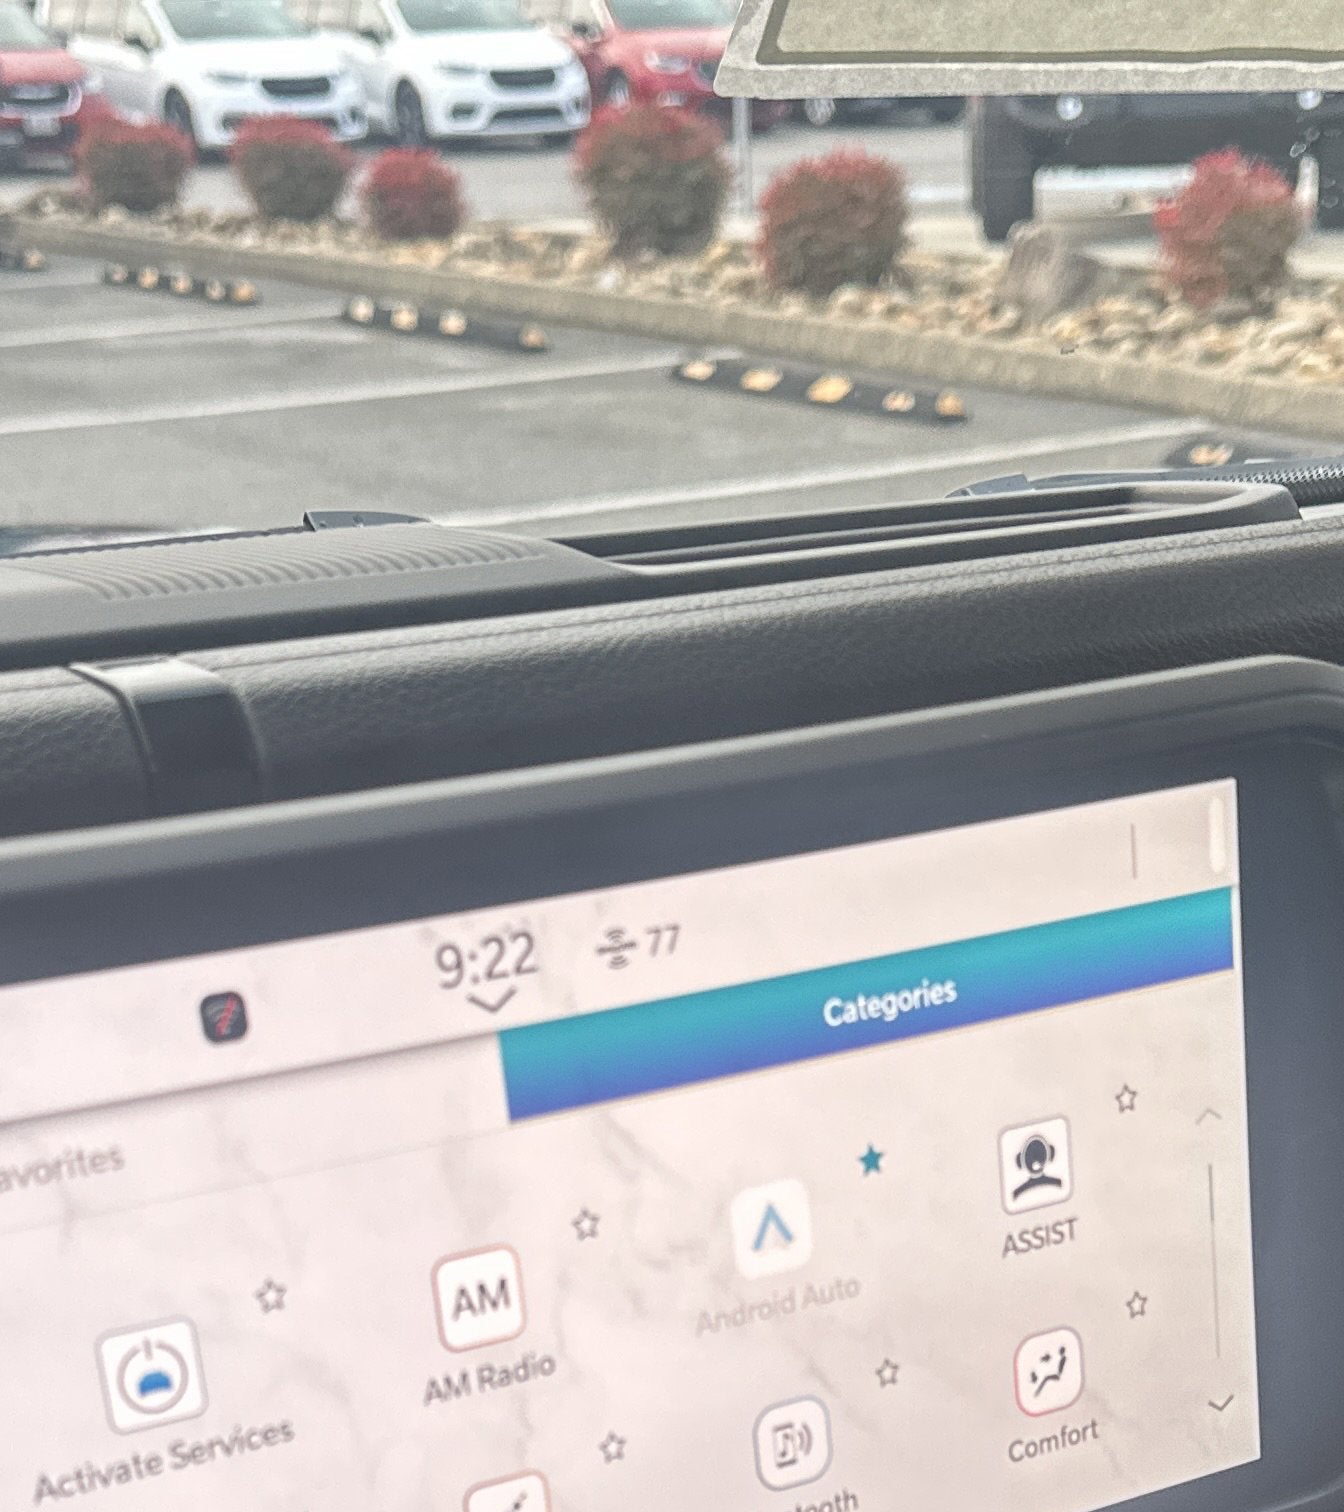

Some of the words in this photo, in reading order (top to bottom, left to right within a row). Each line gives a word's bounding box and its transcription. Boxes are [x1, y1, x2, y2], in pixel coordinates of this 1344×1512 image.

[434, 932, 538, 990] 9:22
[646, 923, 682, 958] 77
[823, 977, 959, 1029] Categories
[1001, 1219, 1078, 1260] ASSIST
[451, 1278, 512, 1322] AM
[693, 1292, 798, 1340] Android
[803, 1273, 863, 1310] Auto
[423, 1370, 474, 1408] AM
[478, 1350, 558, 1392] Radio
[32, 1451, 165, 1508] Activate
[167, 1419, 298, 1471] Services
[1007, 1417, 1101, 1465] Comfort
